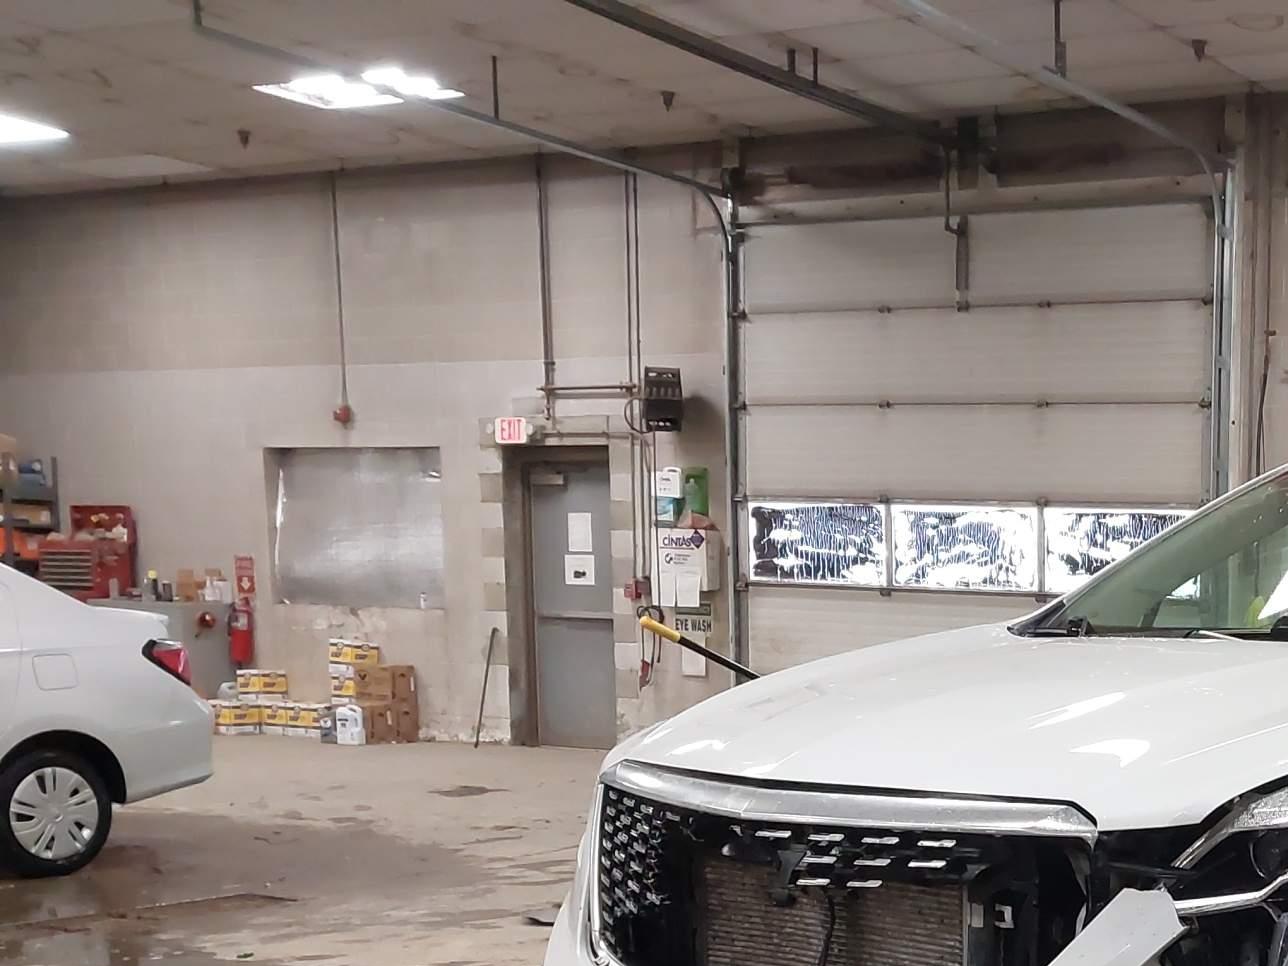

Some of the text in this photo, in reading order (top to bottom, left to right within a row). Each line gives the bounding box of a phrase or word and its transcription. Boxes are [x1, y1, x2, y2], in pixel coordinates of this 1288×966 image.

[501, 419, 521, 440] EXIT
[662, 534, 692, 547] CINTAS
[675, 618, 712, 633] EYE WASH
